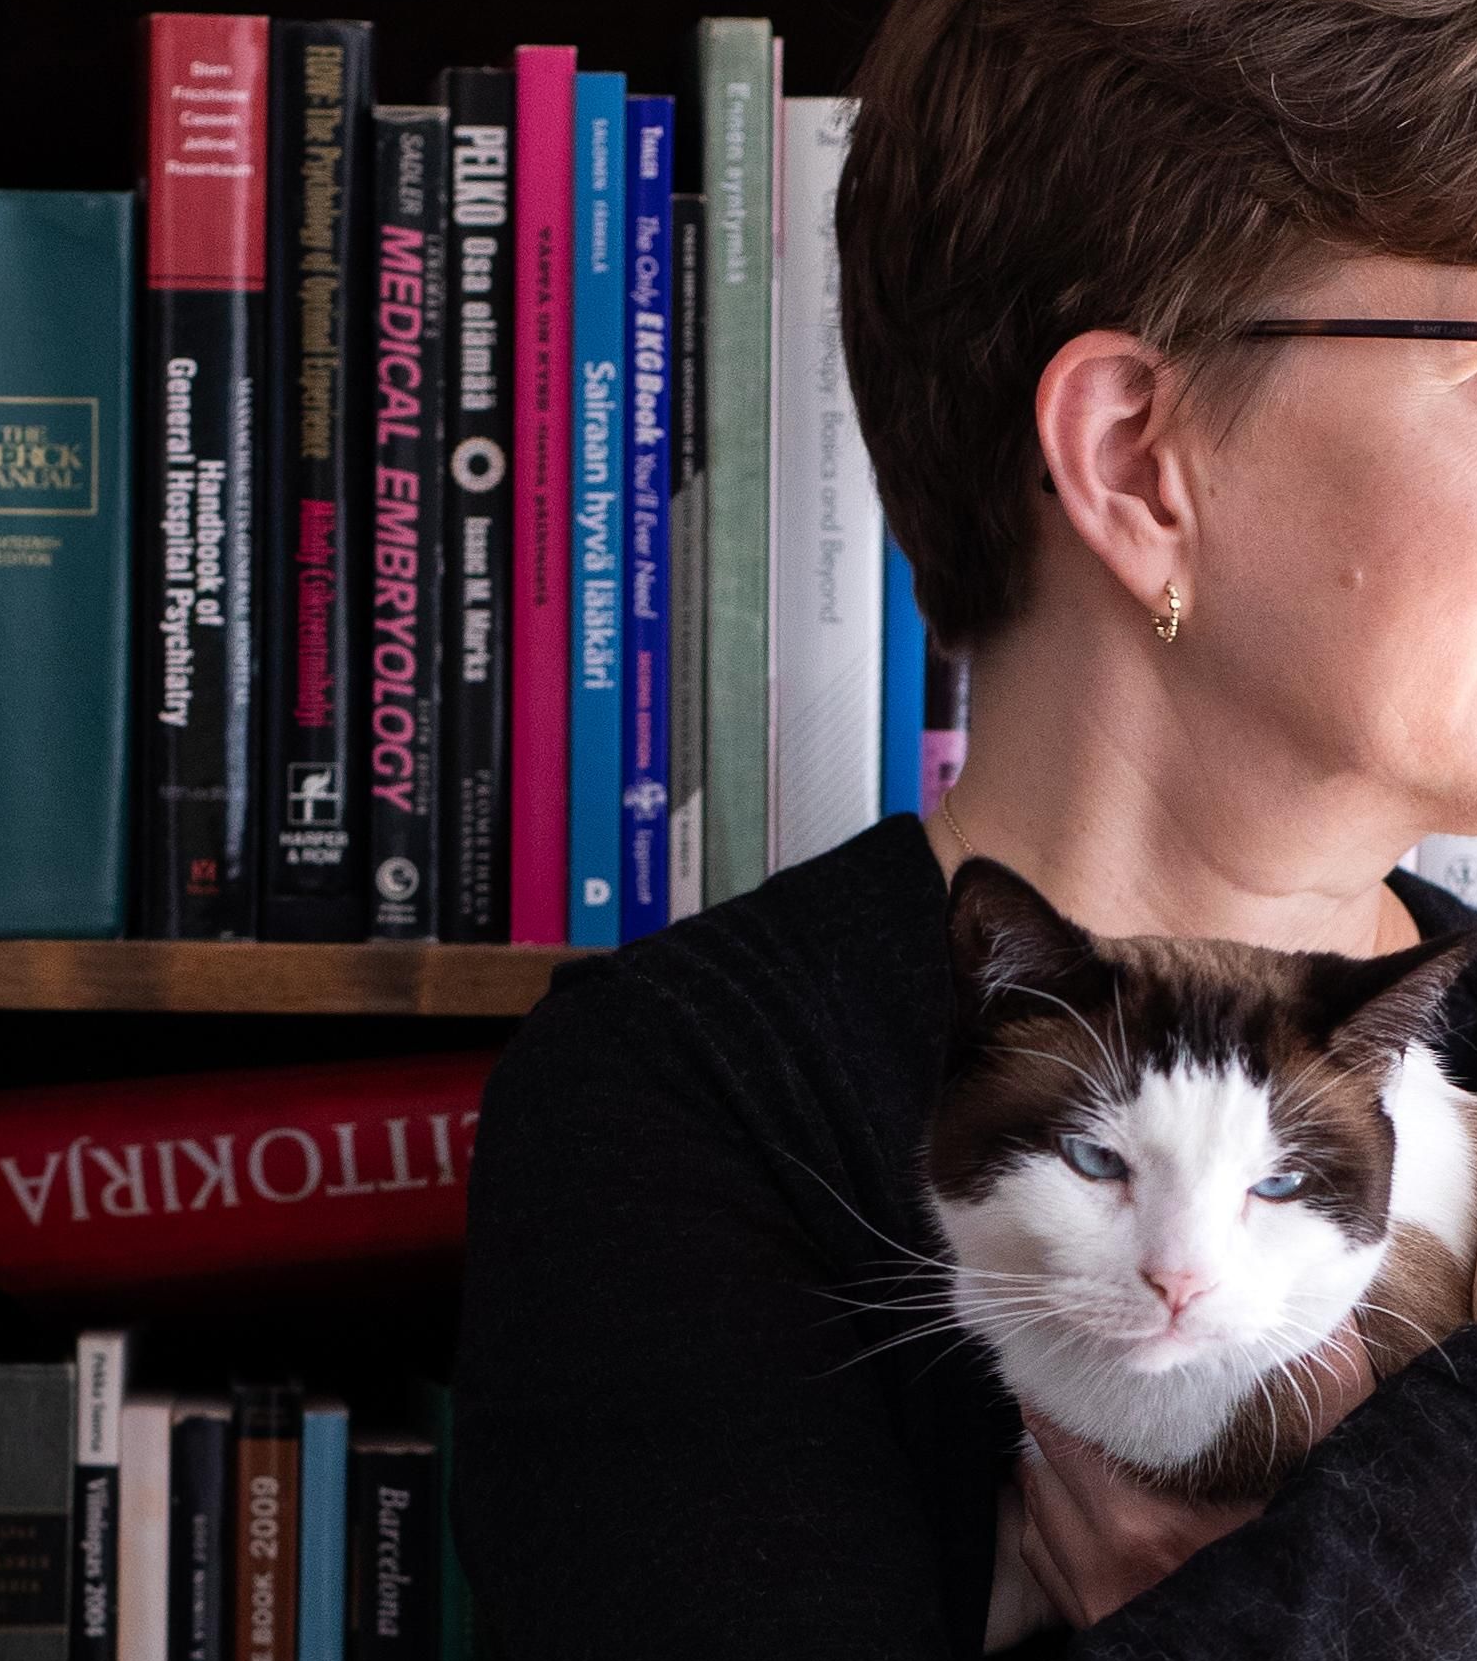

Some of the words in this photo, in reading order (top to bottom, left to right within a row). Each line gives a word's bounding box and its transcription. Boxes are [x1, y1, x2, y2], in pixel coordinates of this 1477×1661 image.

[399, 133, 422, 215] SADLER
[453, 125, 507, 228] PELKO
[462, 237, 499, 292] Osa
[636, 215, 662, 252] The
[630, 256, 661, 306] Only
[375, 224, 425, 448] MEDICAL
[636, 312, 666, 378] EKG
[165, 357, 198, 462] General
[582, 360, 616, 476] Sairaan
[633, 381, 665, 448] Book
[161, 471, 195, 580] Hospital
[195, 460, 227, 592] Handbook
[580, 485, 615, 562] hyvä
[194, 598, 225, 626] of
[581, 565, 615, 691] lääkäri
[631, 566, 656, 621] Need
[158, 587, 193, 726] Psychiatry
[369, 462, 423, 815] EMBRYOLOGY
[250, 1475, 279, 1560] 2009
[375, 1485, 411, 1638] Barcelona
[252, 1572, 275, 1645] BOOK
